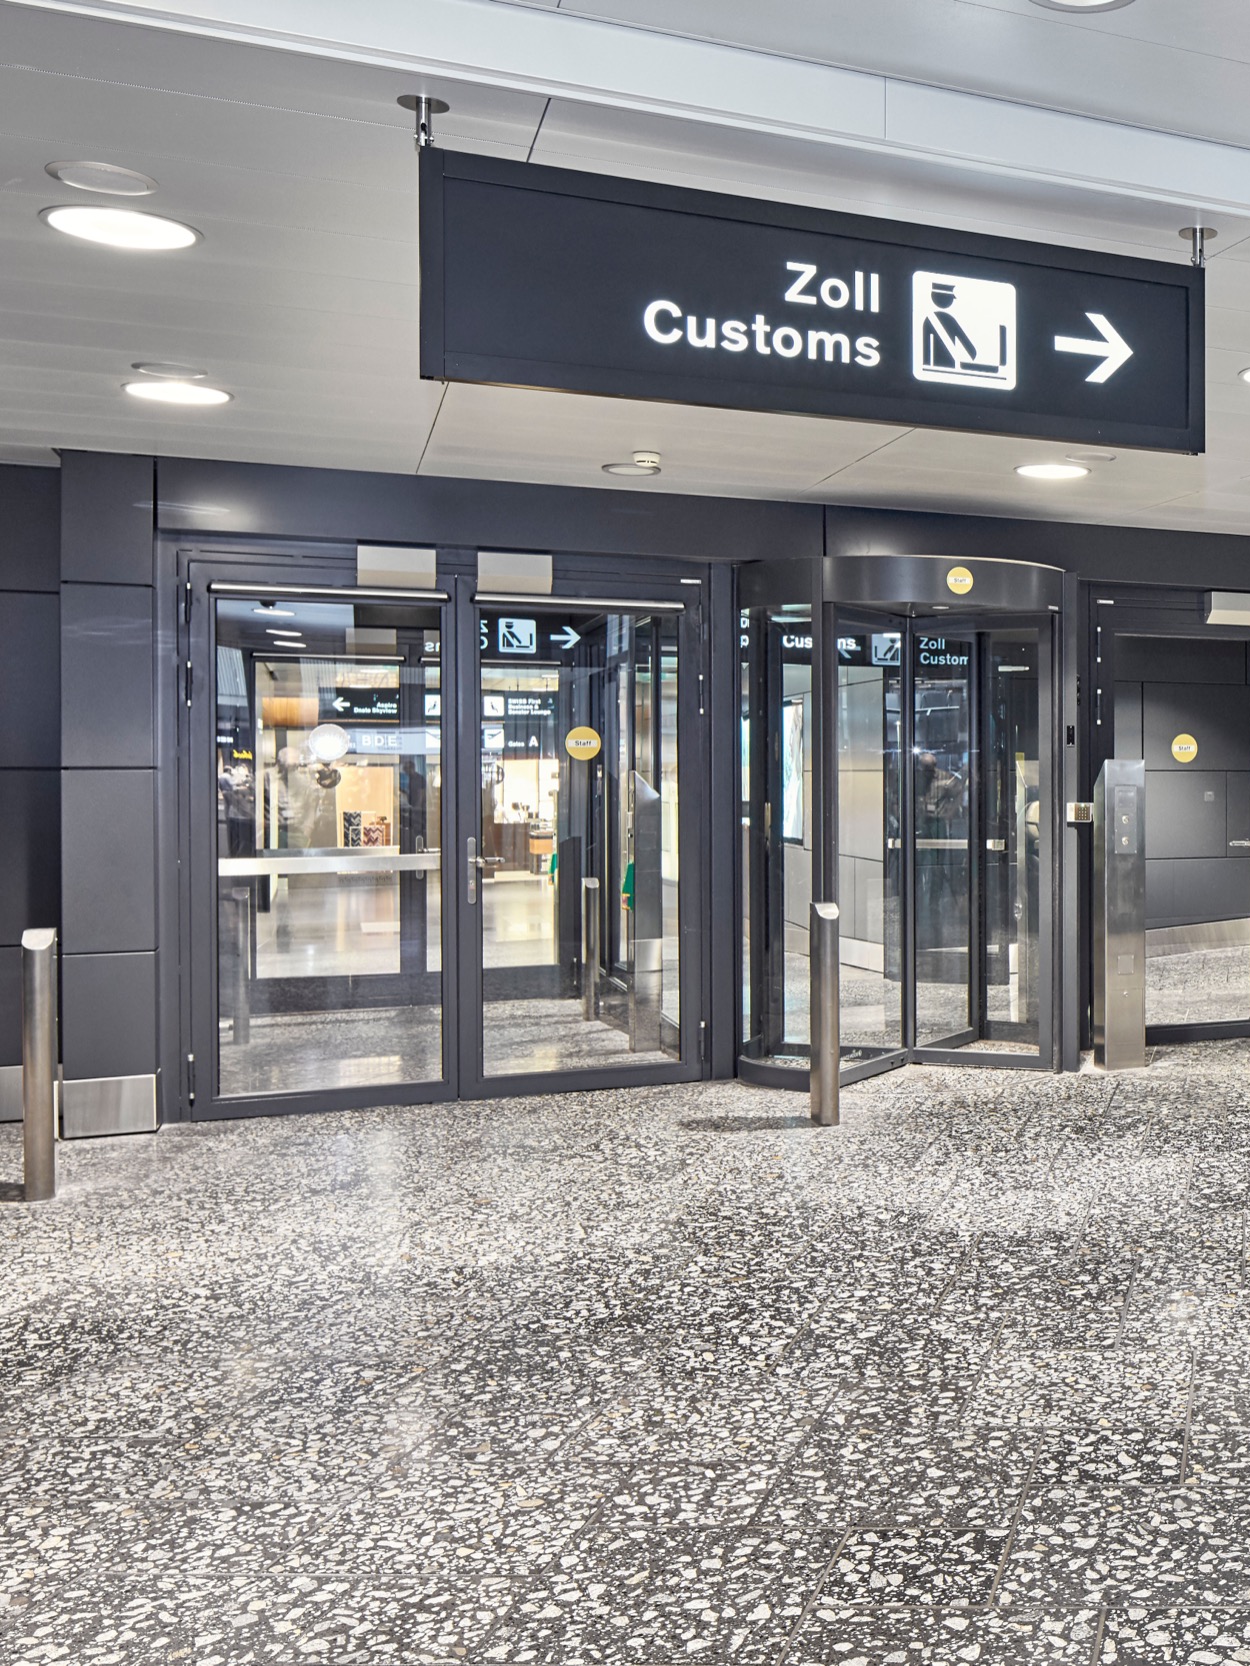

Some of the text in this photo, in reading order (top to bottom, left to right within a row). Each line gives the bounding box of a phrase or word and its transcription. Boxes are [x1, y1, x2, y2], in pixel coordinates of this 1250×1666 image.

[785, 261, 880, 313] Zoll
[643, 299, 881, 367] Customs
[919, 637, 945, 650] Zoll
[529, 736, 538, 747] A
